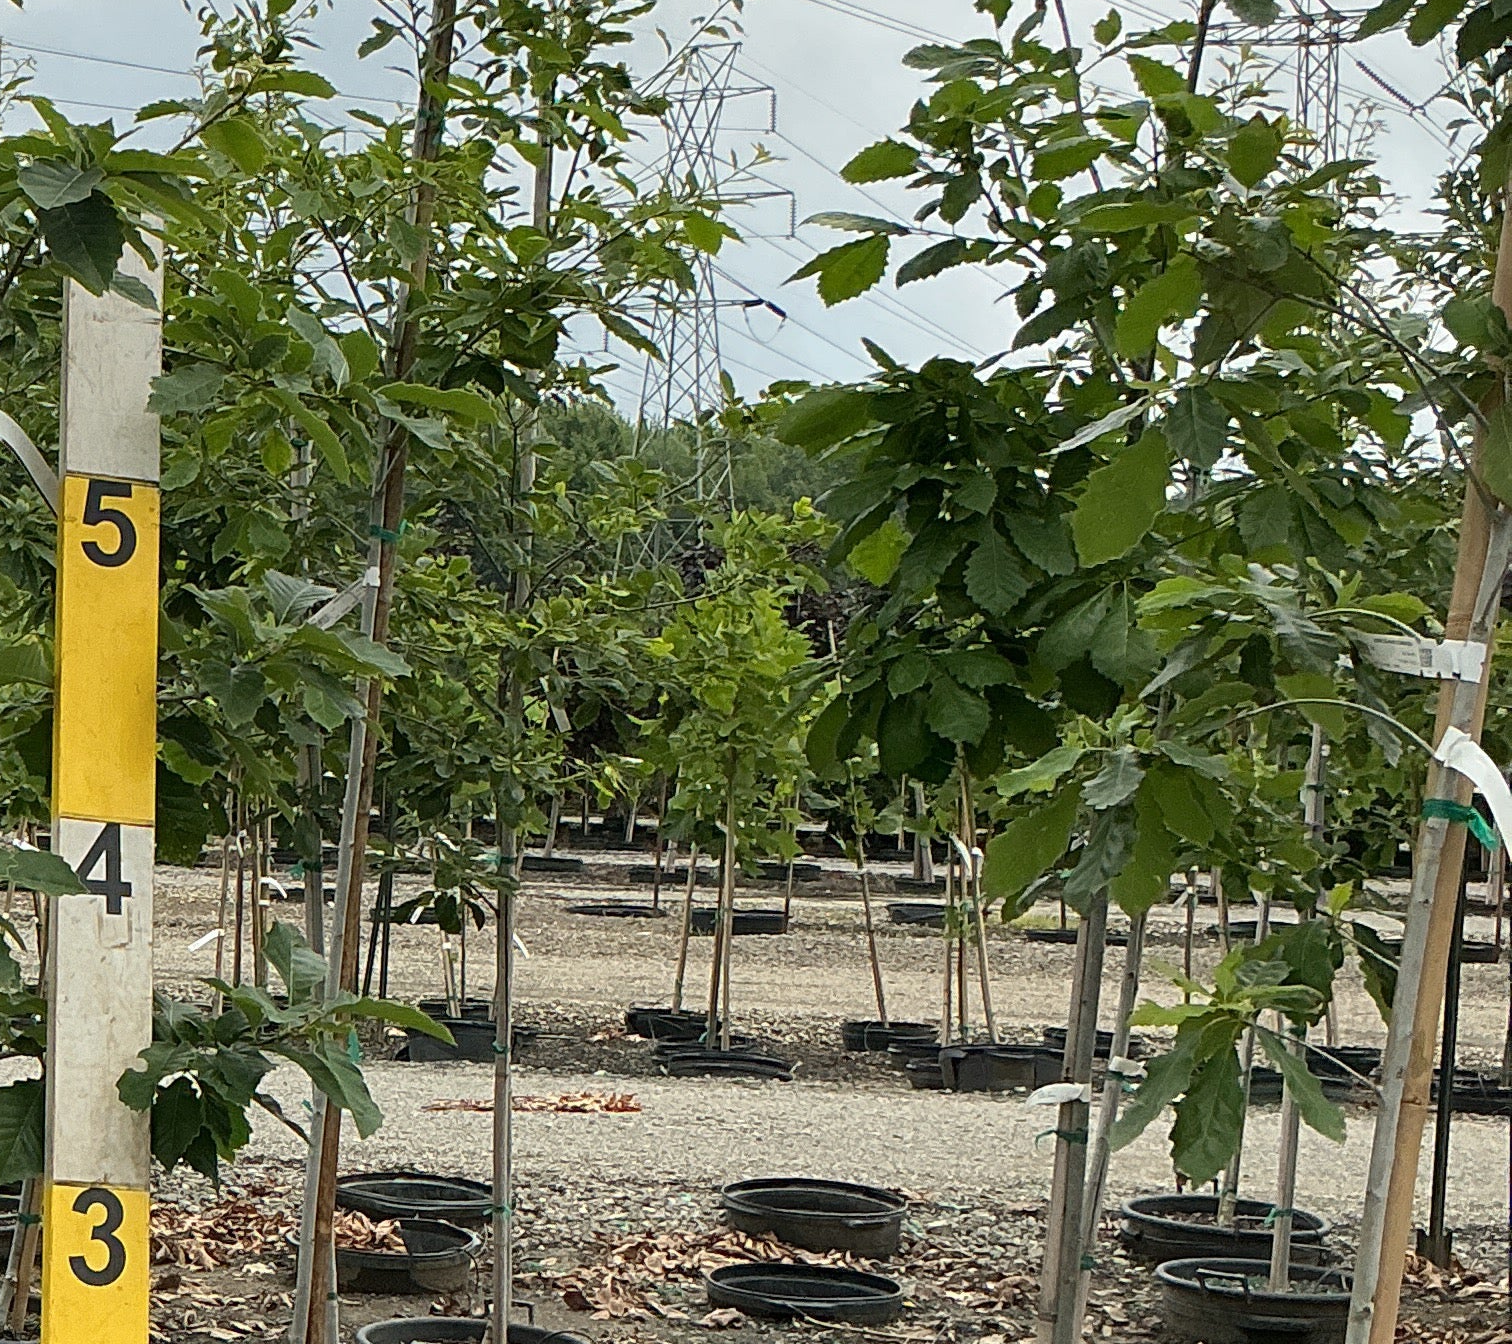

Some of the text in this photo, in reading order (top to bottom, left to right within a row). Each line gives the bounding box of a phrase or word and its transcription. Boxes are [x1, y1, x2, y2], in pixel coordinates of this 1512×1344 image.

[81, 479, 137, 567] 5
[76, 822, 132, 915] 4
[68, 1187, 126, 1286] 3
